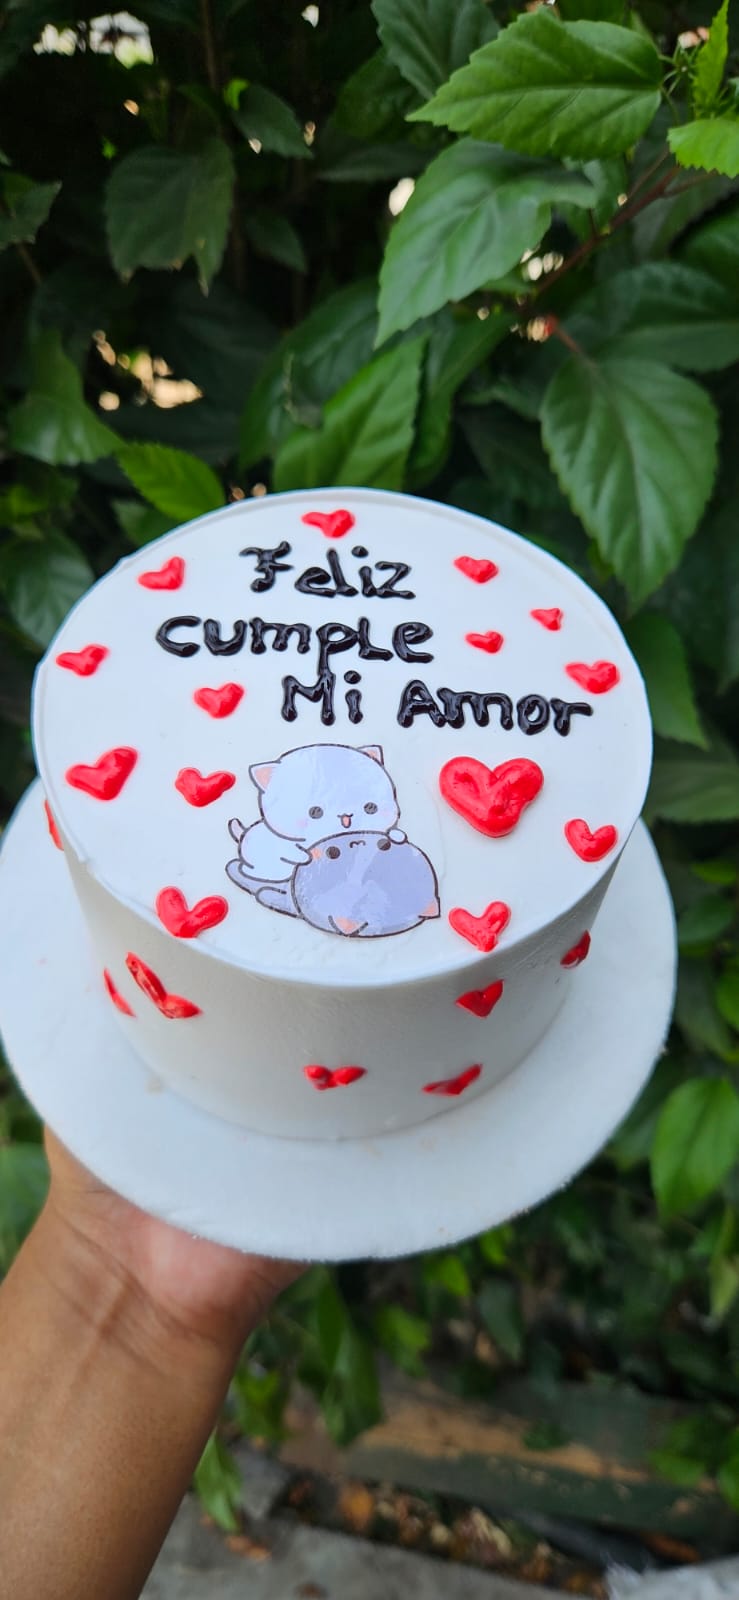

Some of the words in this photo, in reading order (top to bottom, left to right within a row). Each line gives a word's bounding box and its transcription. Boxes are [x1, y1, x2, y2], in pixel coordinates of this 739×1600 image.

[240, 540, 416, 600] Feliz
[281, 669, 364, 726] Mi
[397, 679, 594, 737] Amor
